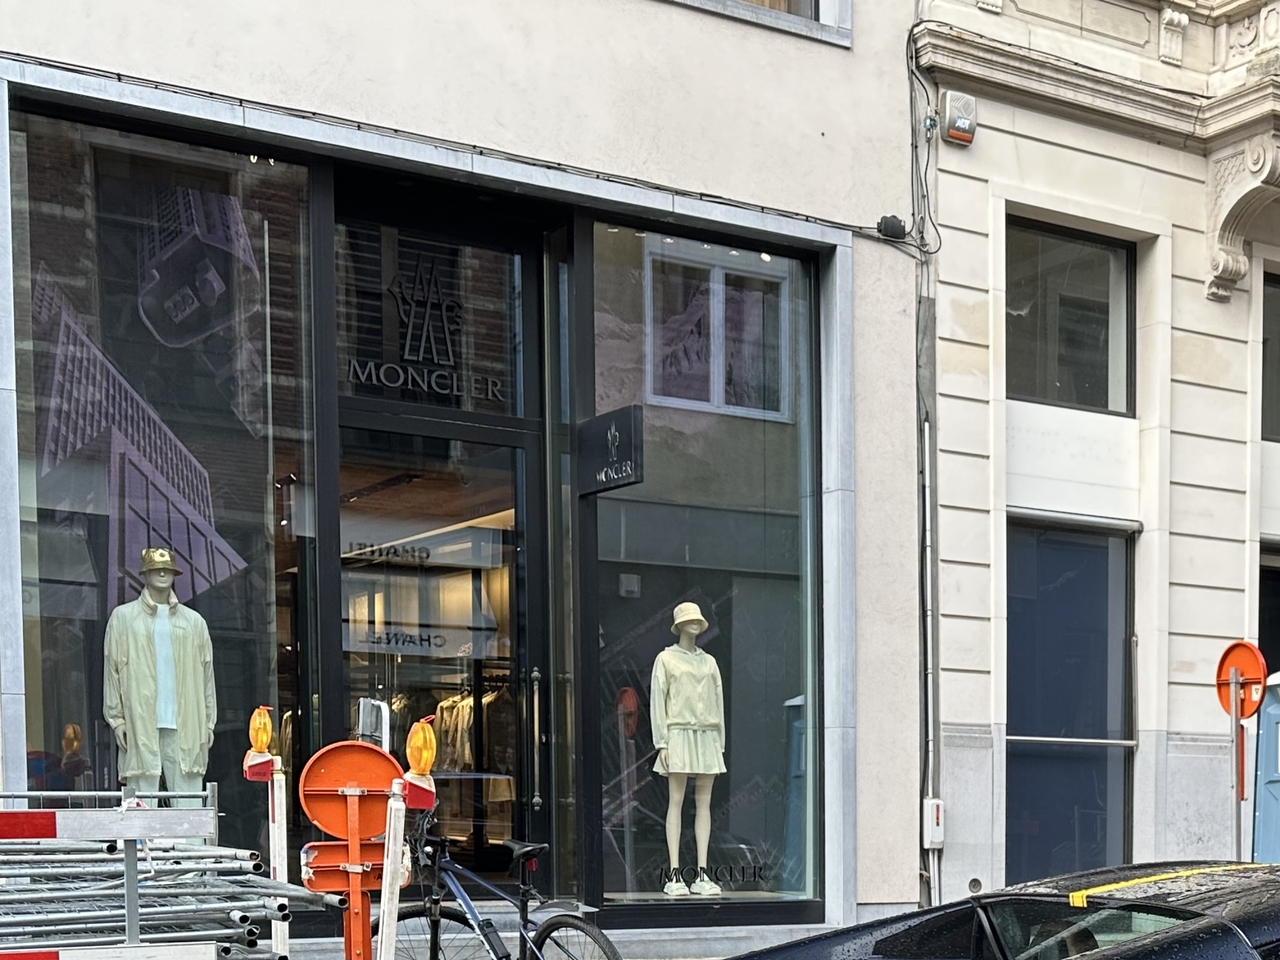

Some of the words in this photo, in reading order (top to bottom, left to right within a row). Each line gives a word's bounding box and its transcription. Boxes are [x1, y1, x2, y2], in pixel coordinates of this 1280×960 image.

[348, 359, 506, 401] MONCLER
[595, 460, 632, 483] MONCLER
[660, 865, 766, 883] MONCLER
